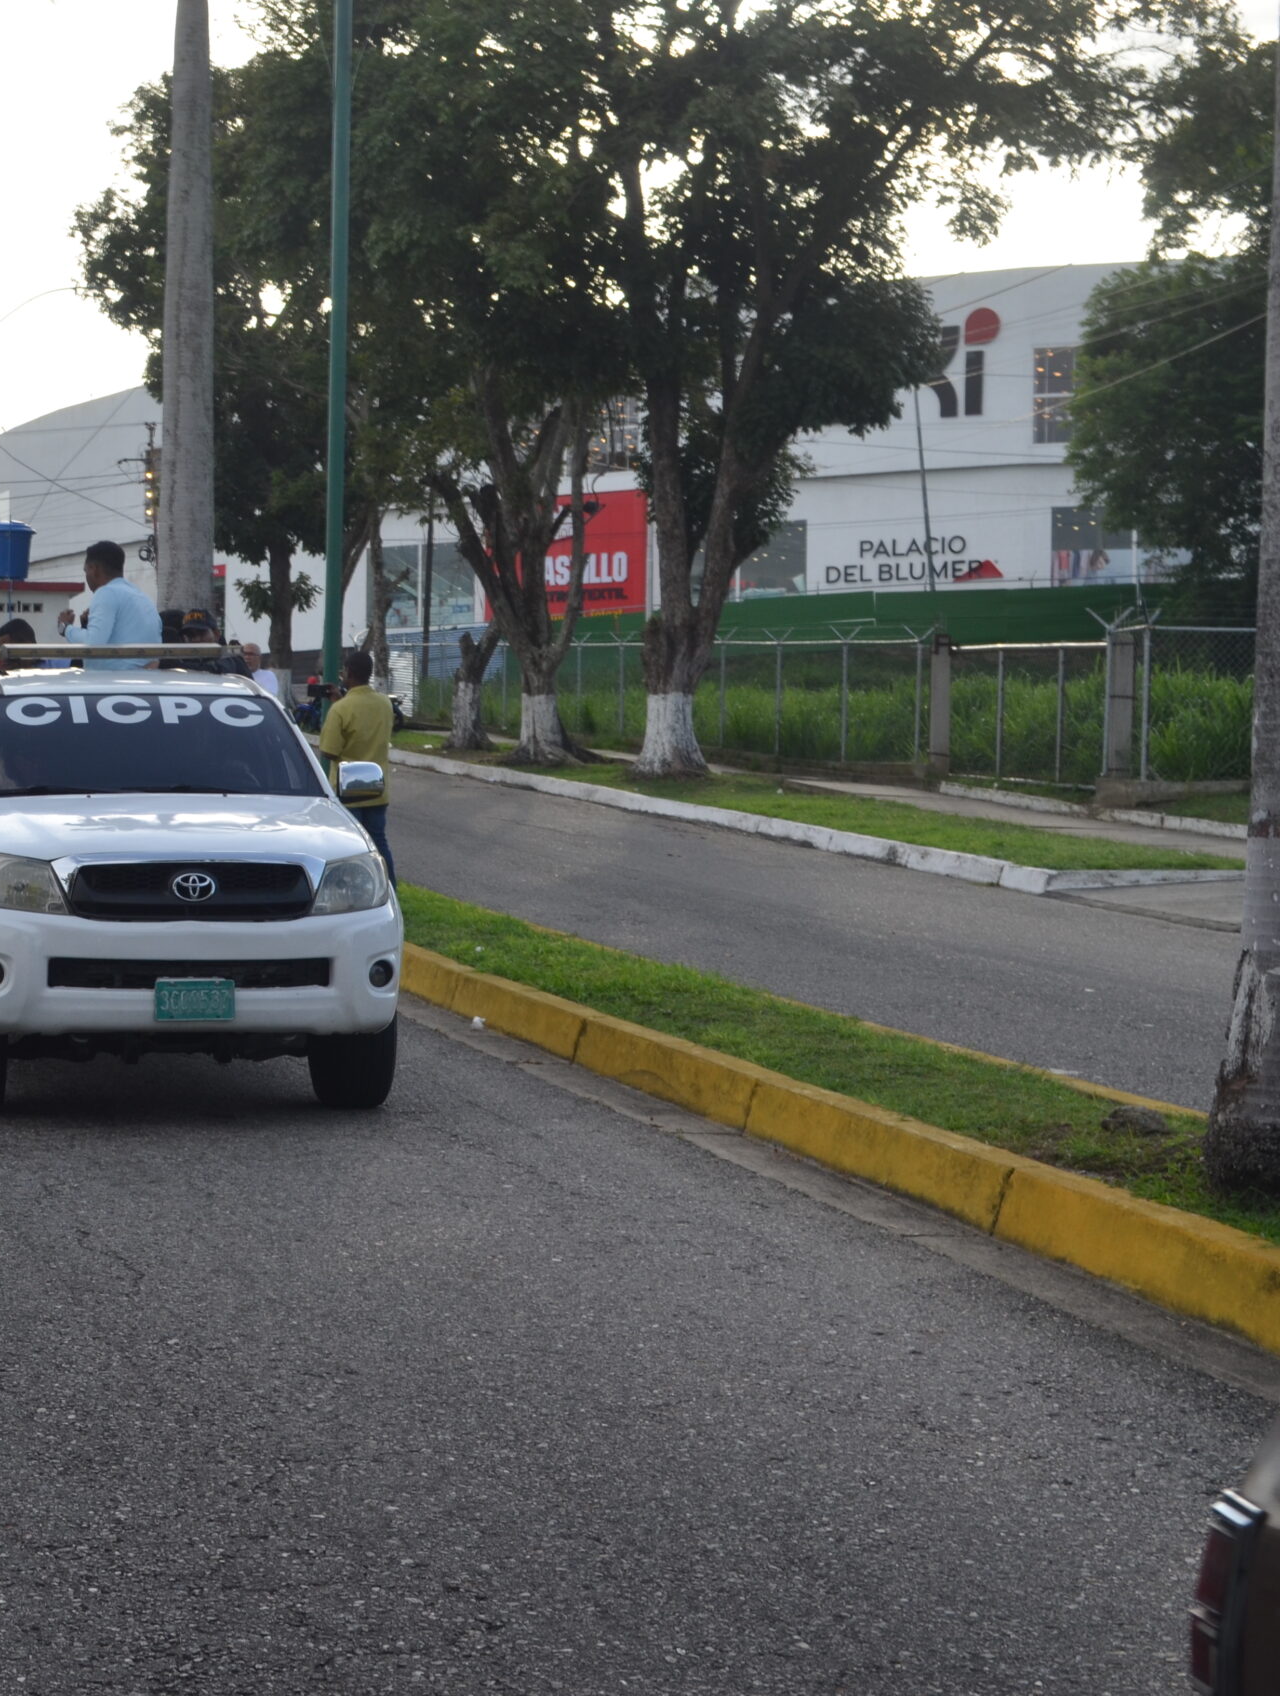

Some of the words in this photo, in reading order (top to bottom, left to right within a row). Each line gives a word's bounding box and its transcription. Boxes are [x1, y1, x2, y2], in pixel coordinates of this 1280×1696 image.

[859, 535, 967, 559] PALACIO
[825, 564, 872, 584] DEL
[878, 560, 984, 582] BLUMER
[6, 695, 265, 728] CICPC
